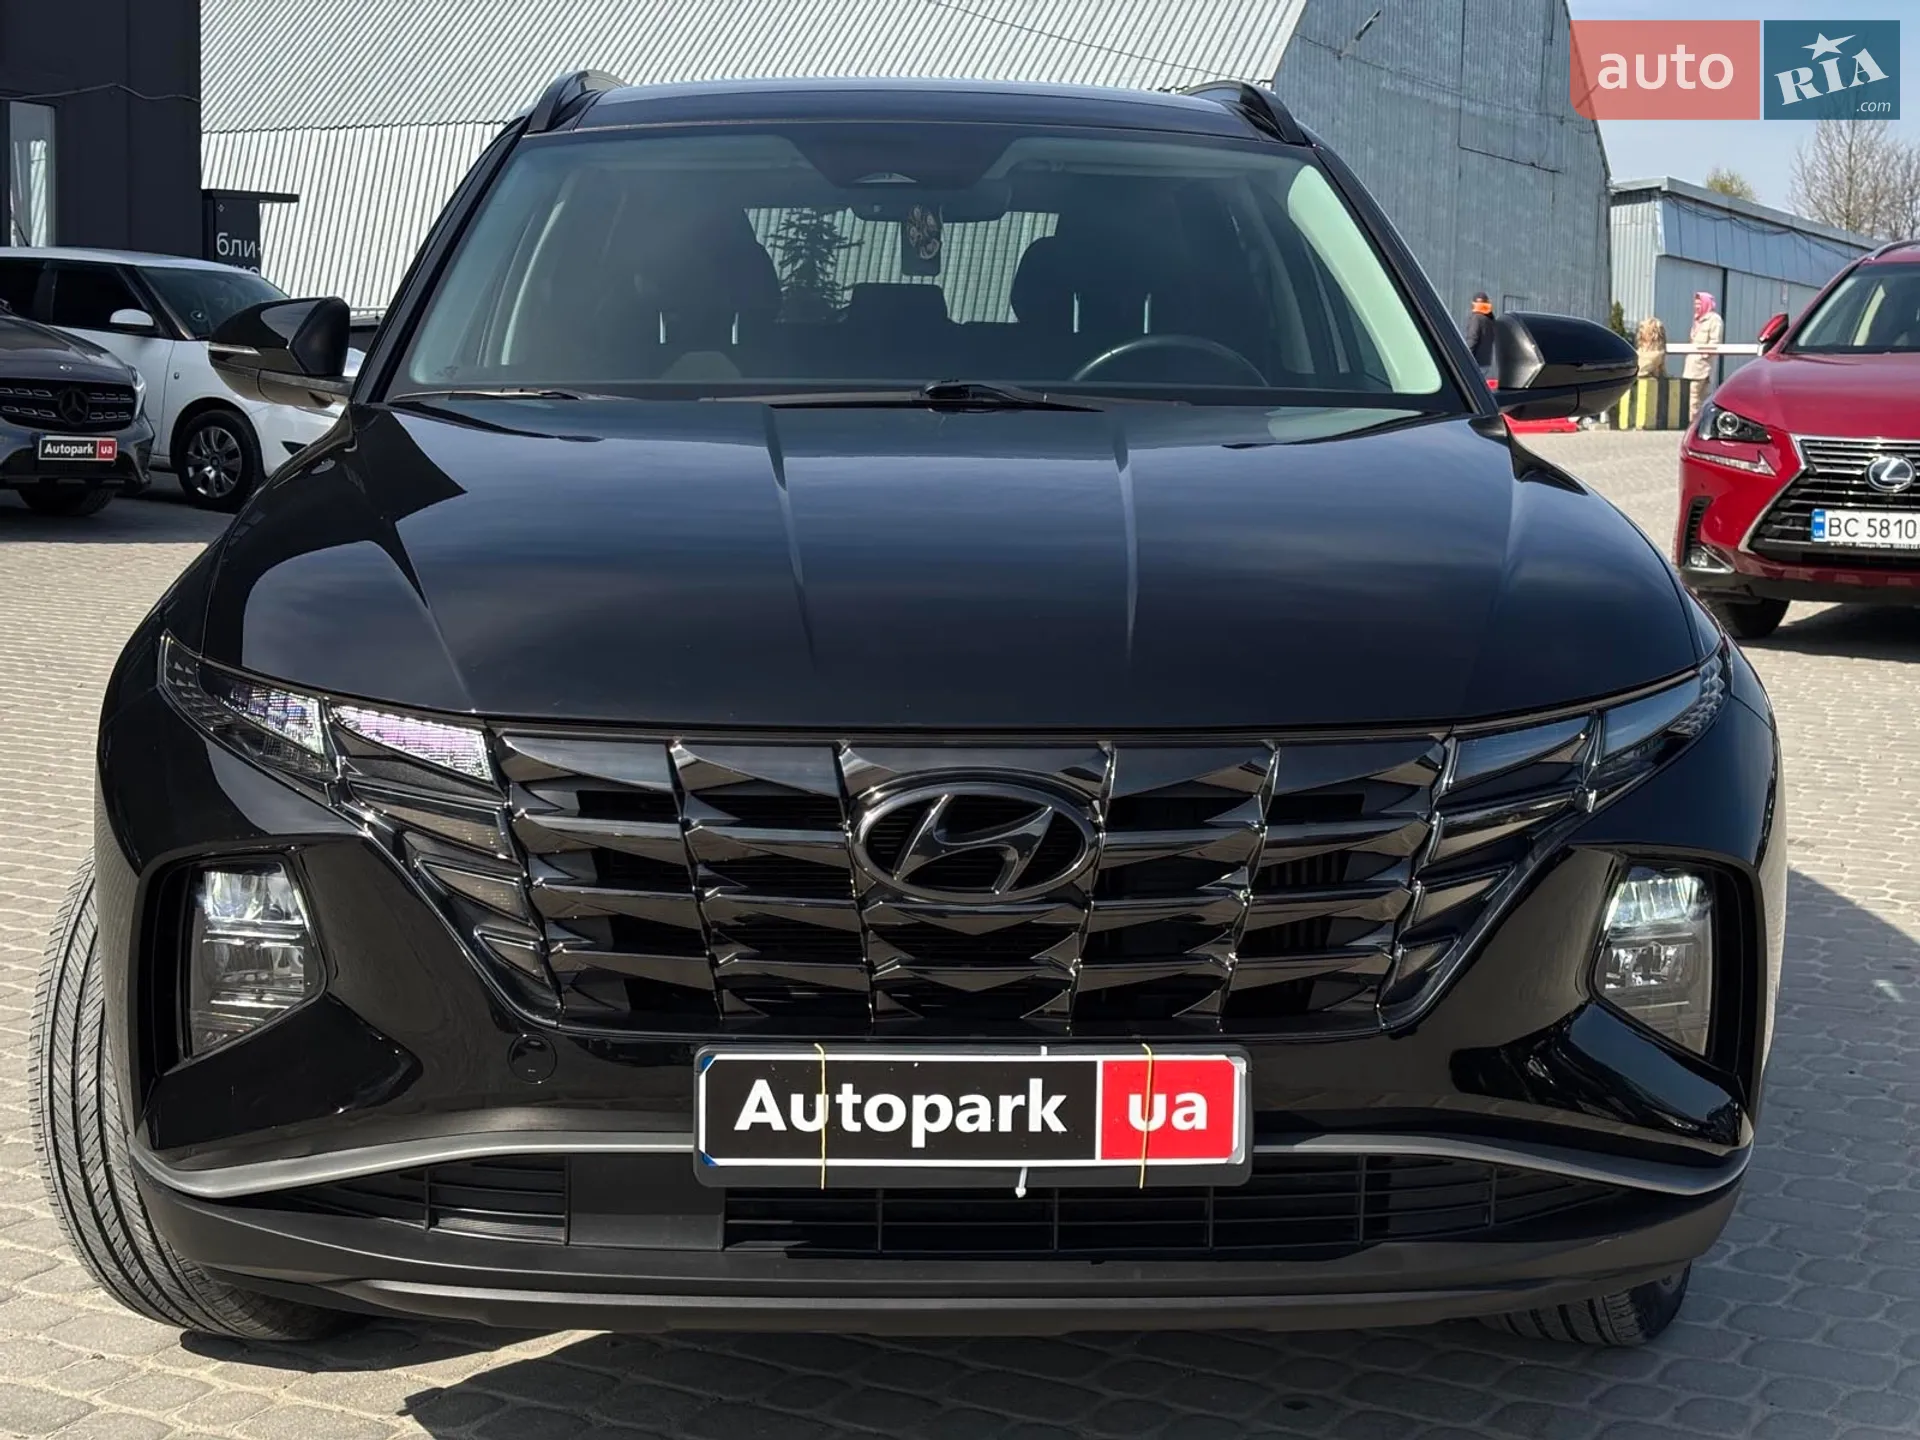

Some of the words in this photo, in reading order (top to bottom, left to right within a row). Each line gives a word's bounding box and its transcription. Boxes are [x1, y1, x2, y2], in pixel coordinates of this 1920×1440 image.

[44, 443, 94, 457] Autopark
[100, 445, 113, 454] ua
[1828, 517, 1859, 537] BC
[1866, 518, 1917, 539] 5810
[733, 1077, 1068, 1148] Autopark
[1127, 1090, 1208, 1131] ua
